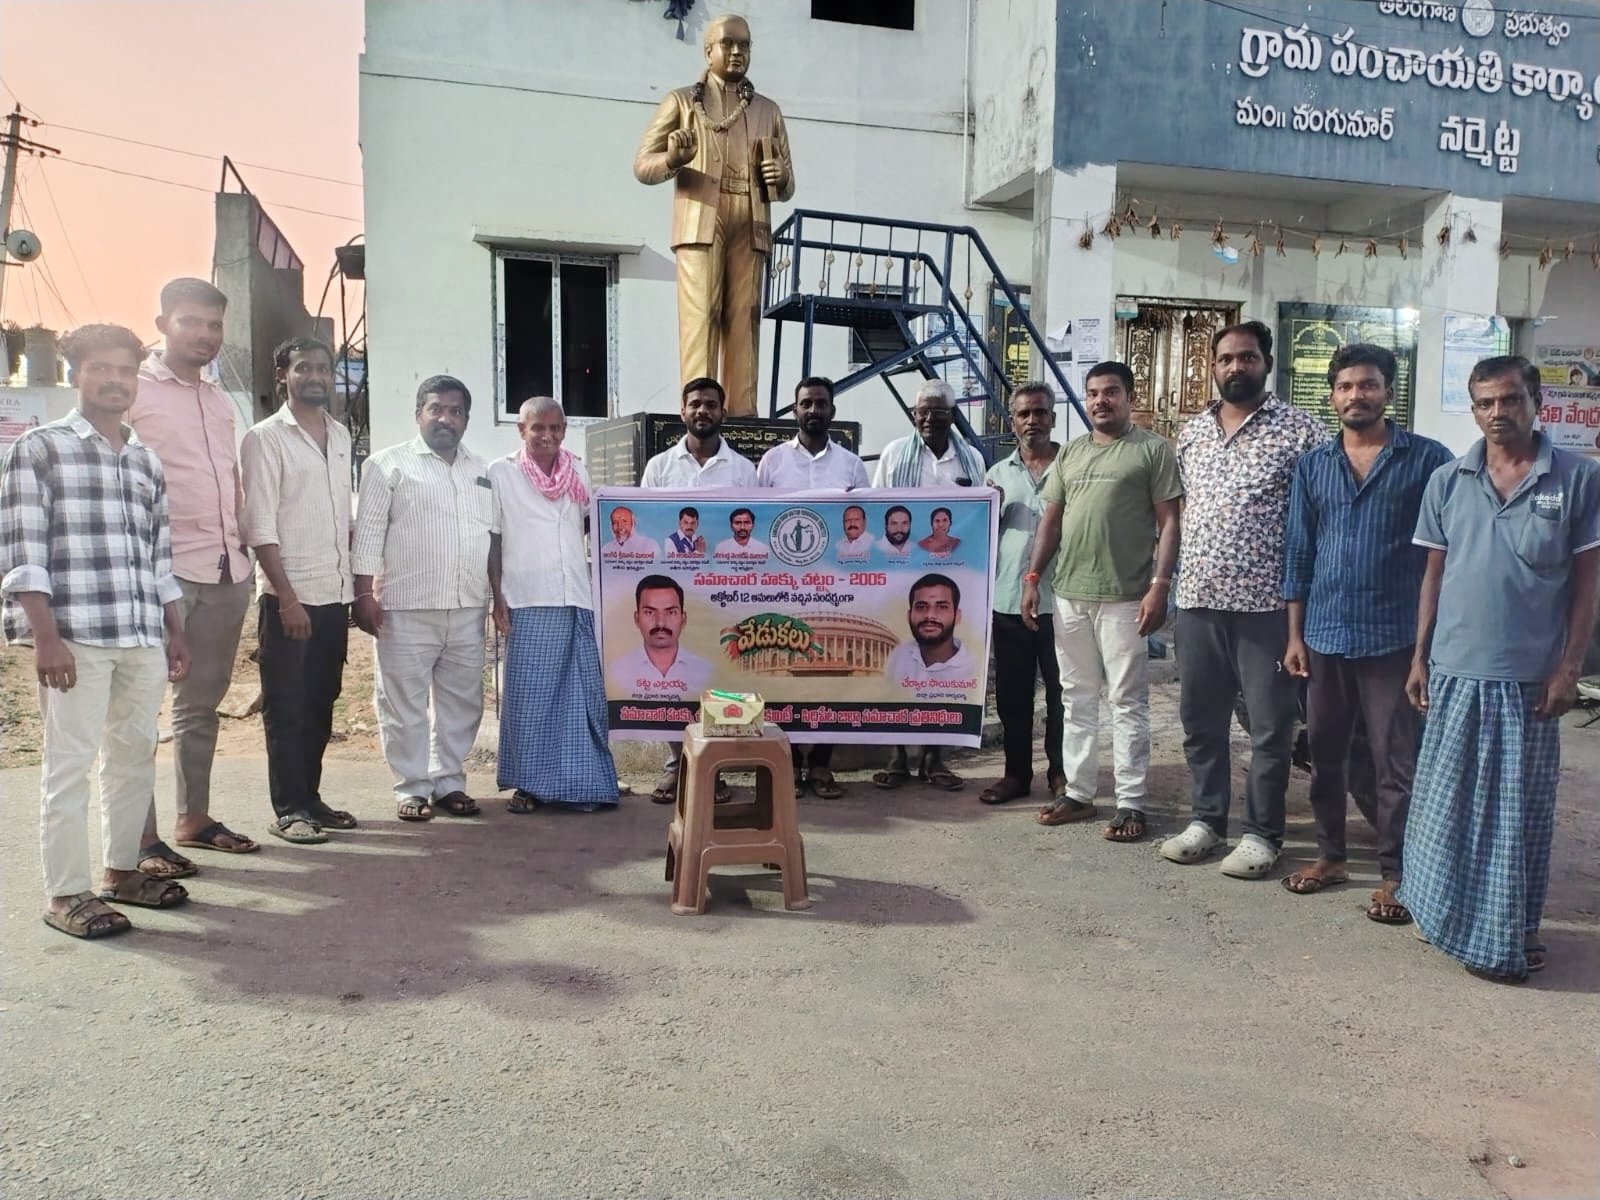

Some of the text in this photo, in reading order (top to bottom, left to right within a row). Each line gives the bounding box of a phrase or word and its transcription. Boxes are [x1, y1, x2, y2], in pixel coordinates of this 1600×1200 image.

[1505, 11, 1570, 46] ప్రభుత్వం
[1239, 22, 1322, 78] గ్రామ
[1512, 62, 1600, 121] కార్యా
[1292, 103, 1395, 141] నంగునూర్
[693, 572, 757, 586] సమాచార
[760, 572, 799, 590] హక్కు
[801, 573, 834, 592] చట్టం
[849, 572, 888, 586] 2005
[741, 592, 750, 603] 12
[737, 618, 810, 651] వేడుకలు
